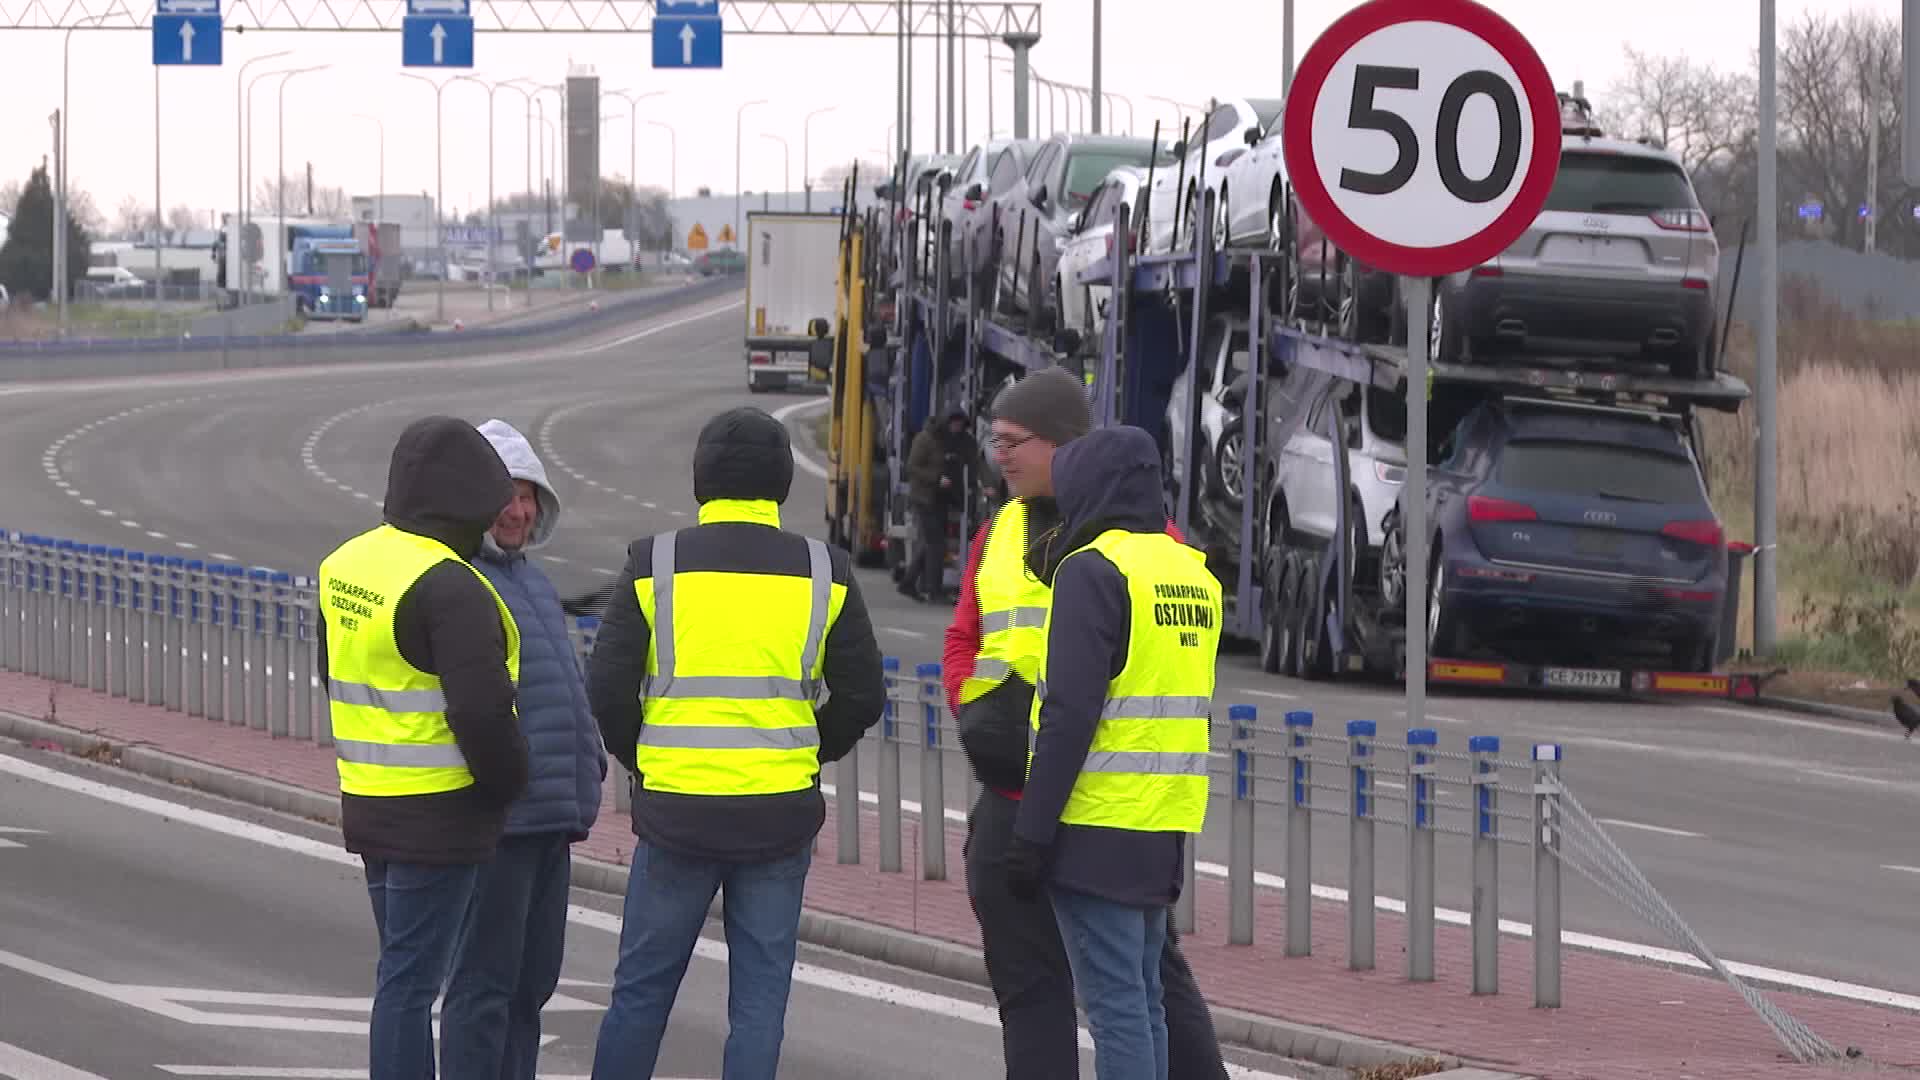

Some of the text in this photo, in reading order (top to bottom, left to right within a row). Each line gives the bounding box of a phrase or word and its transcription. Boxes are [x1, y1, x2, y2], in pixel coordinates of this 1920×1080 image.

[1340, 63, 1522, 204] 50
[328, 577, 385, 607] PODKARPACKA
[1154, 584, 1209, 601] PODKARPACKA
[331, 594, 372, 619] OSZUKANA
[1154, 603, 1213, 629] OSZUKANA
